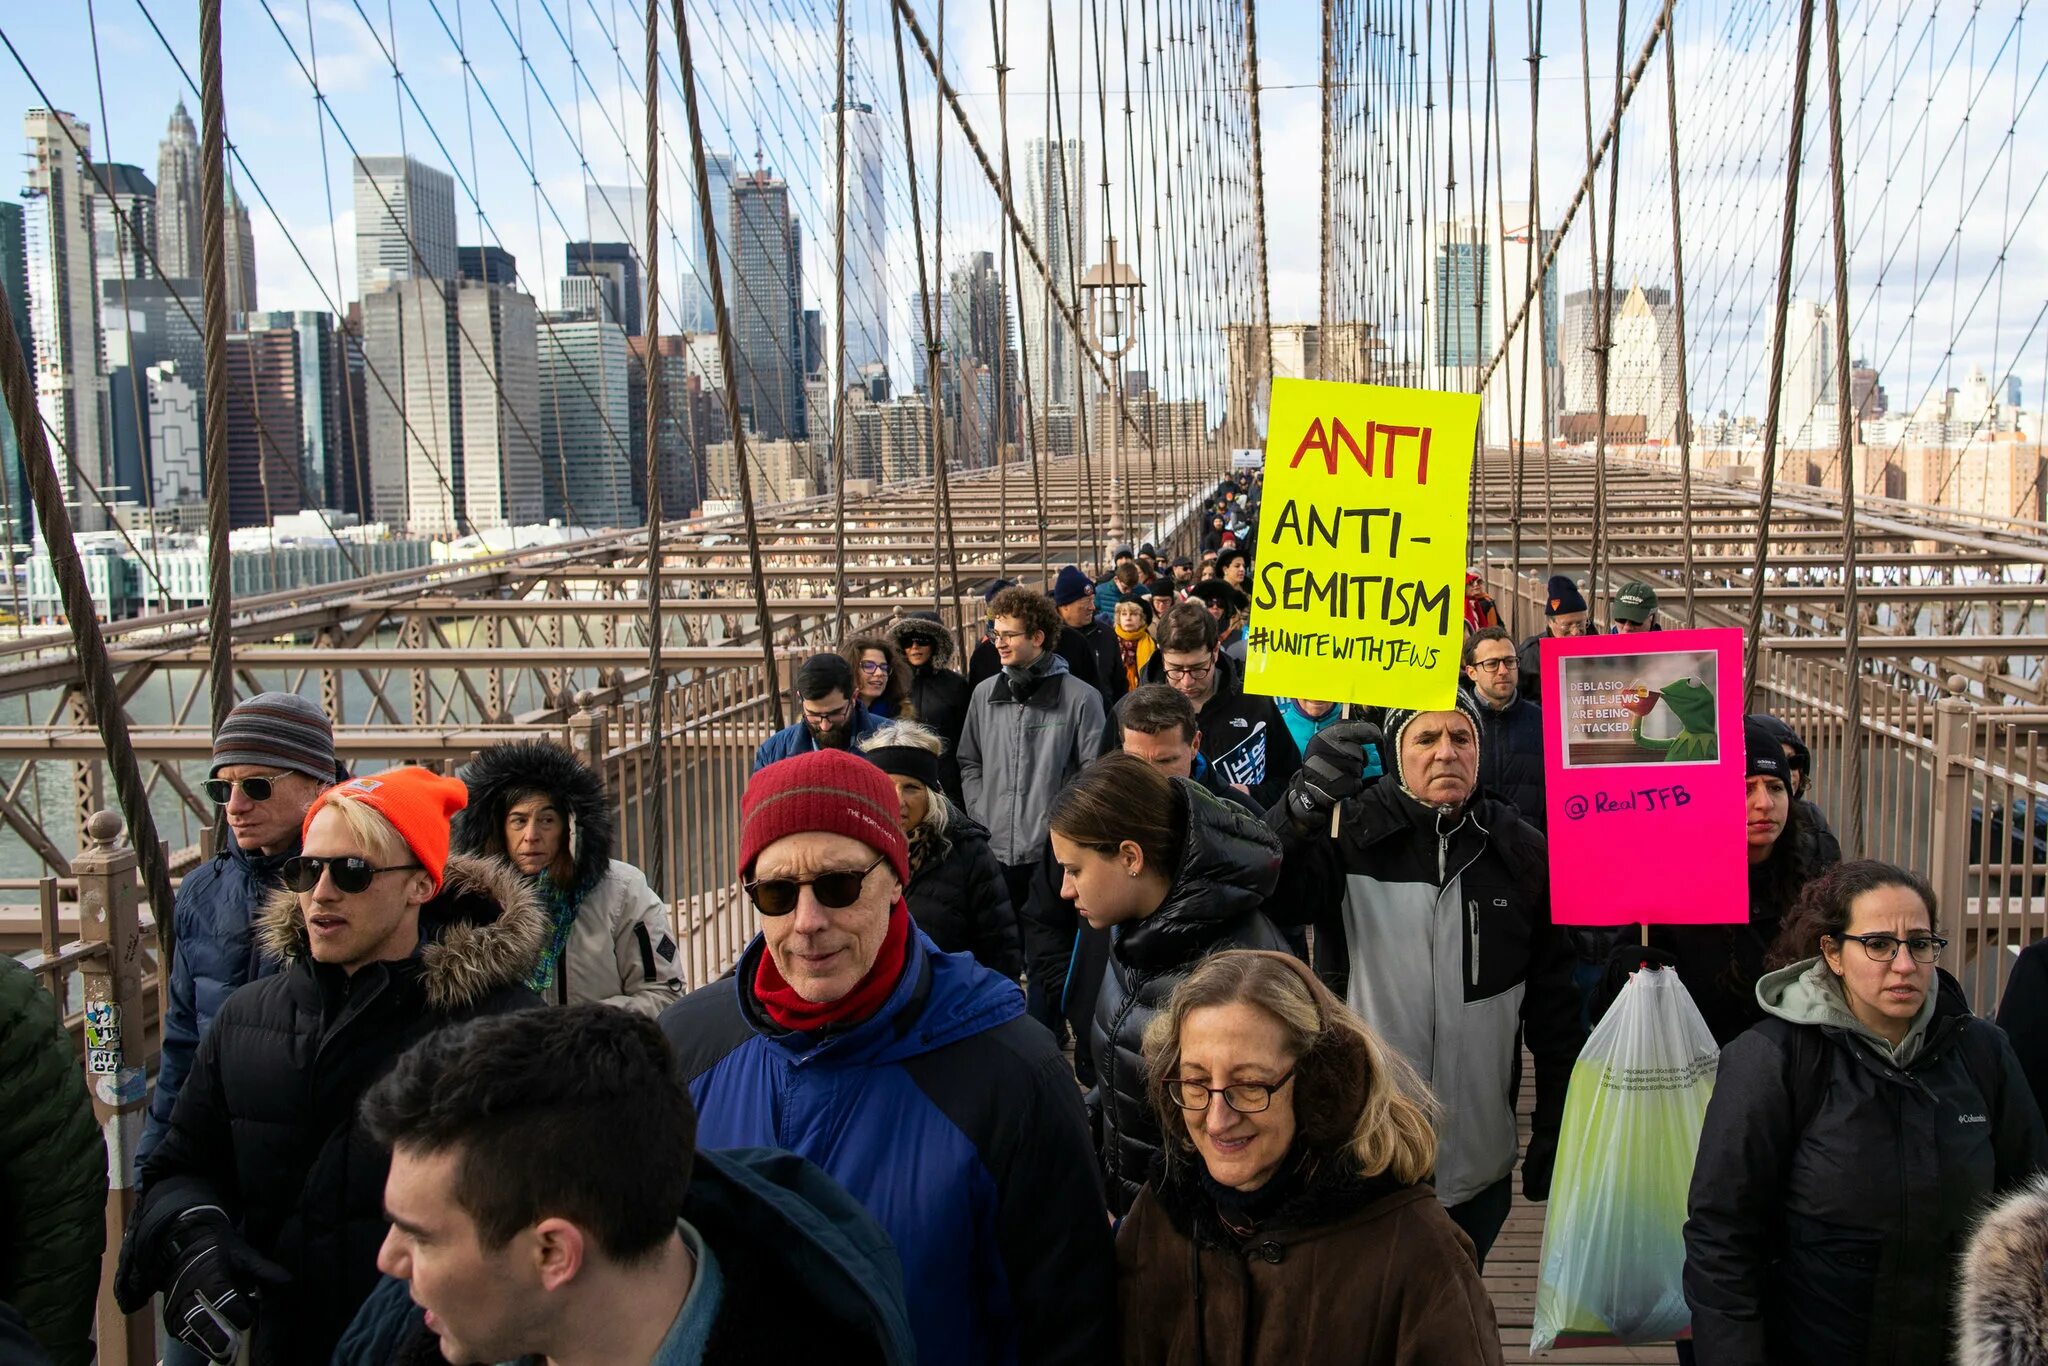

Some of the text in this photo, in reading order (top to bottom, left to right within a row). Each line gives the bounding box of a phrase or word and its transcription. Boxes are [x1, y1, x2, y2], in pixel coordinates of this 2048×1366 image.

[1290, 416, 1432, 485] ANTI
[1271, 500, 1431, 558] ANTI-
[1255, 561, 1450, 636] SEMITISM
[1570, 681, 1624, 691] DEBLASIO
[1572, 693, 1640, 705] WHILE JEWS
[1572, 708, 1630, 719] ARE BEING
[1572, 722, 1638, 732] ATTACKED...
[847, 808, 860, 818] THE
